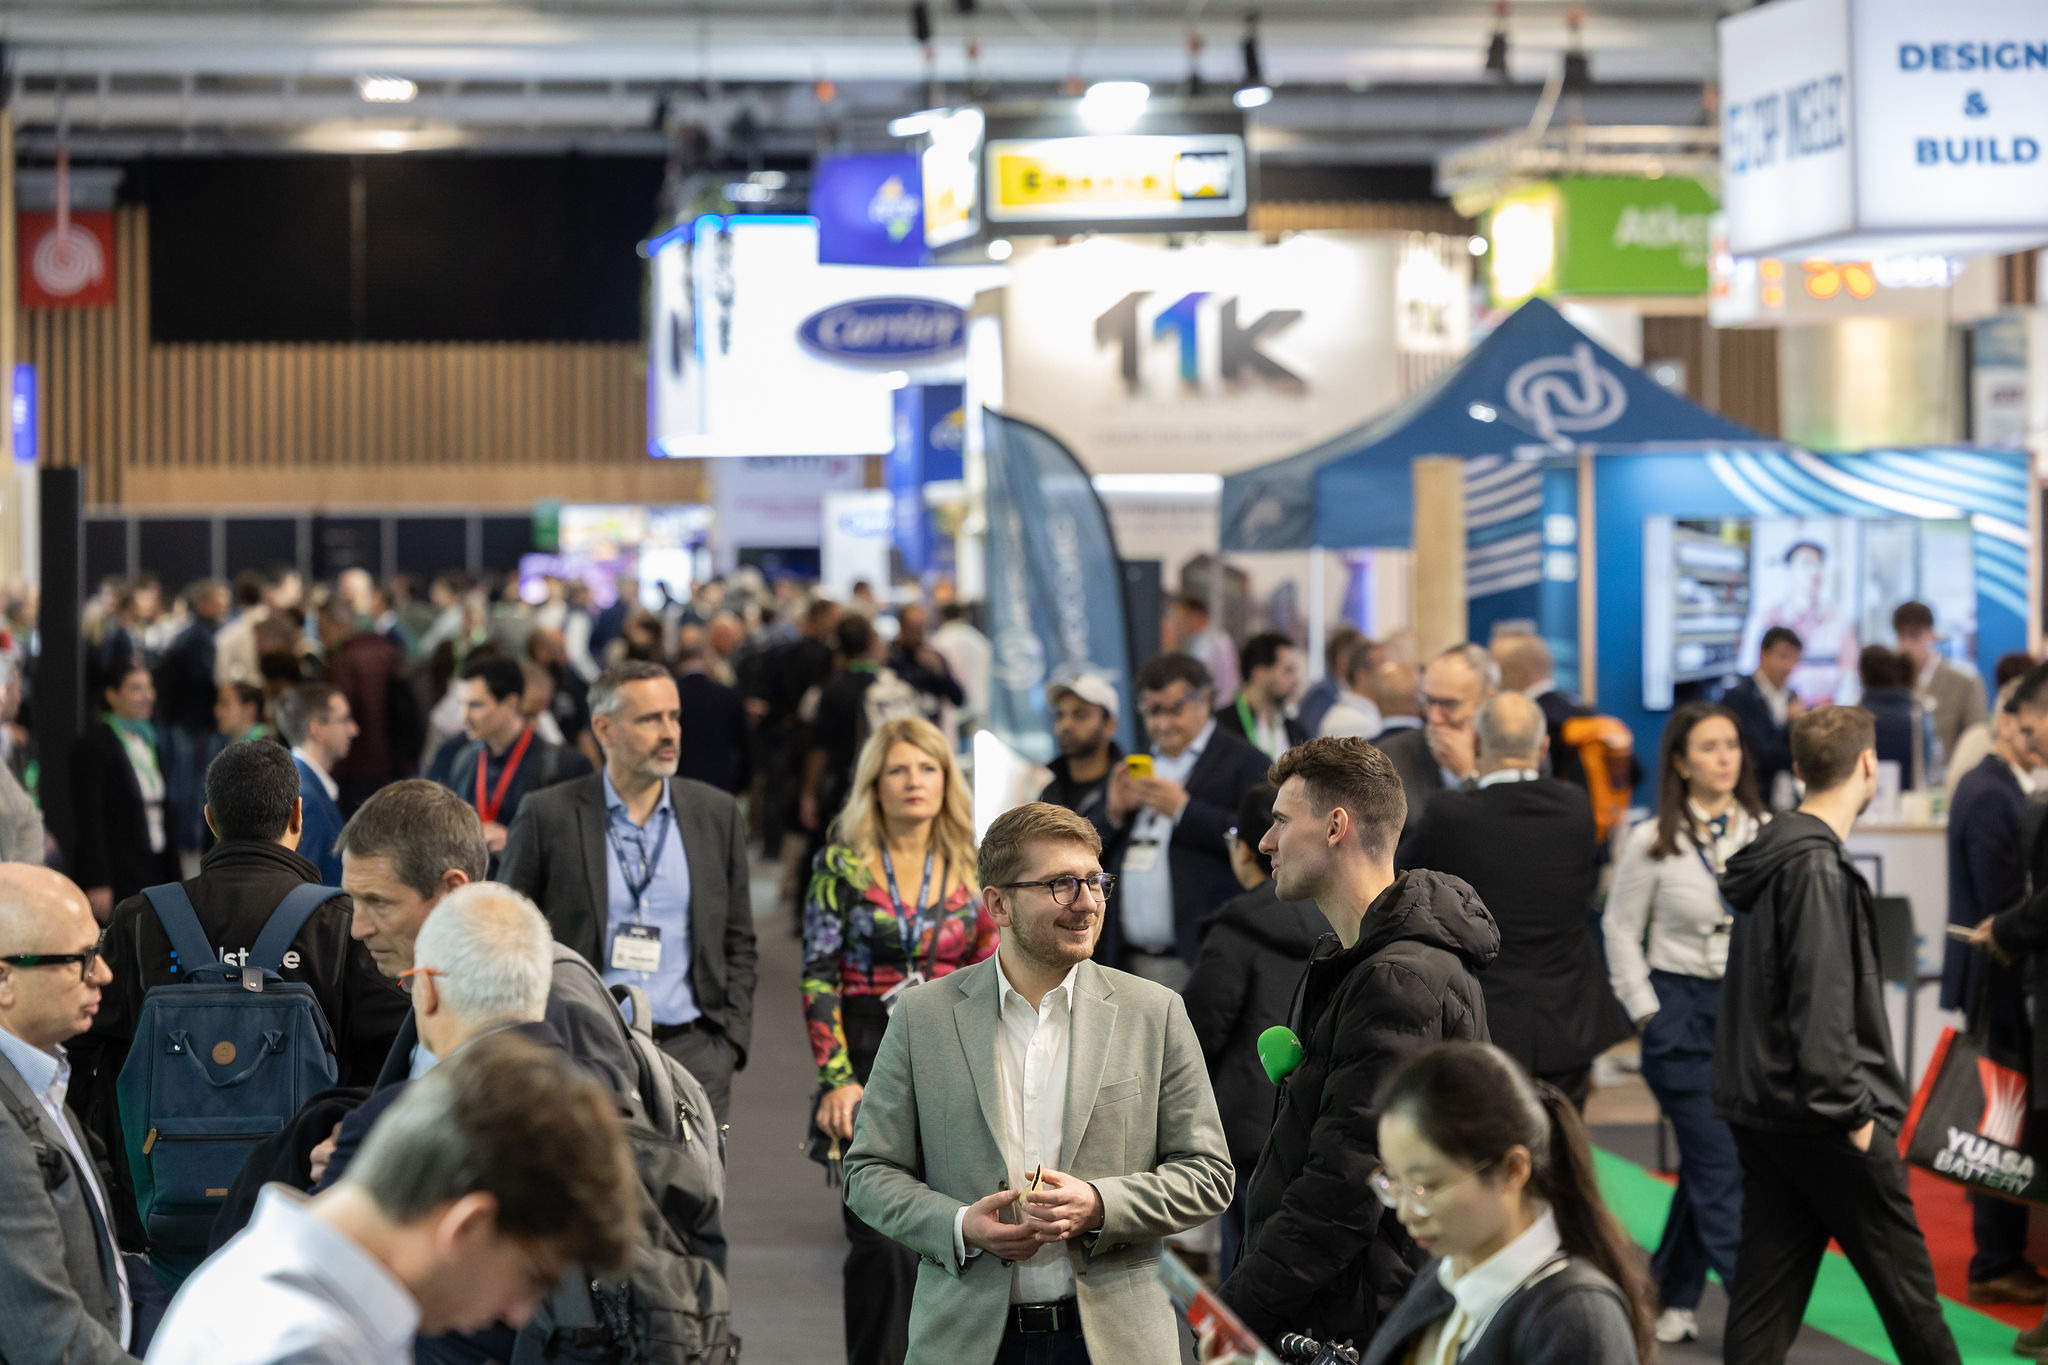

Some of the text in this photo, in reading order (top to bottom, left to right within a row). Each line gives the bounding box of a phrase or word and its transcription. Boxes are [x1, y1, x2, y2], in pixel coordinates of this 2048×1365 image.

[1898, 41, 2048, 72] DESIGN
[1963, 88, 1989, 118] &
[1915, 134, 2040, 166] BUILD
[1947, 1126, 2034, 1180] YUASA
[1933, 1148, 2033, 1195] BATTERY
